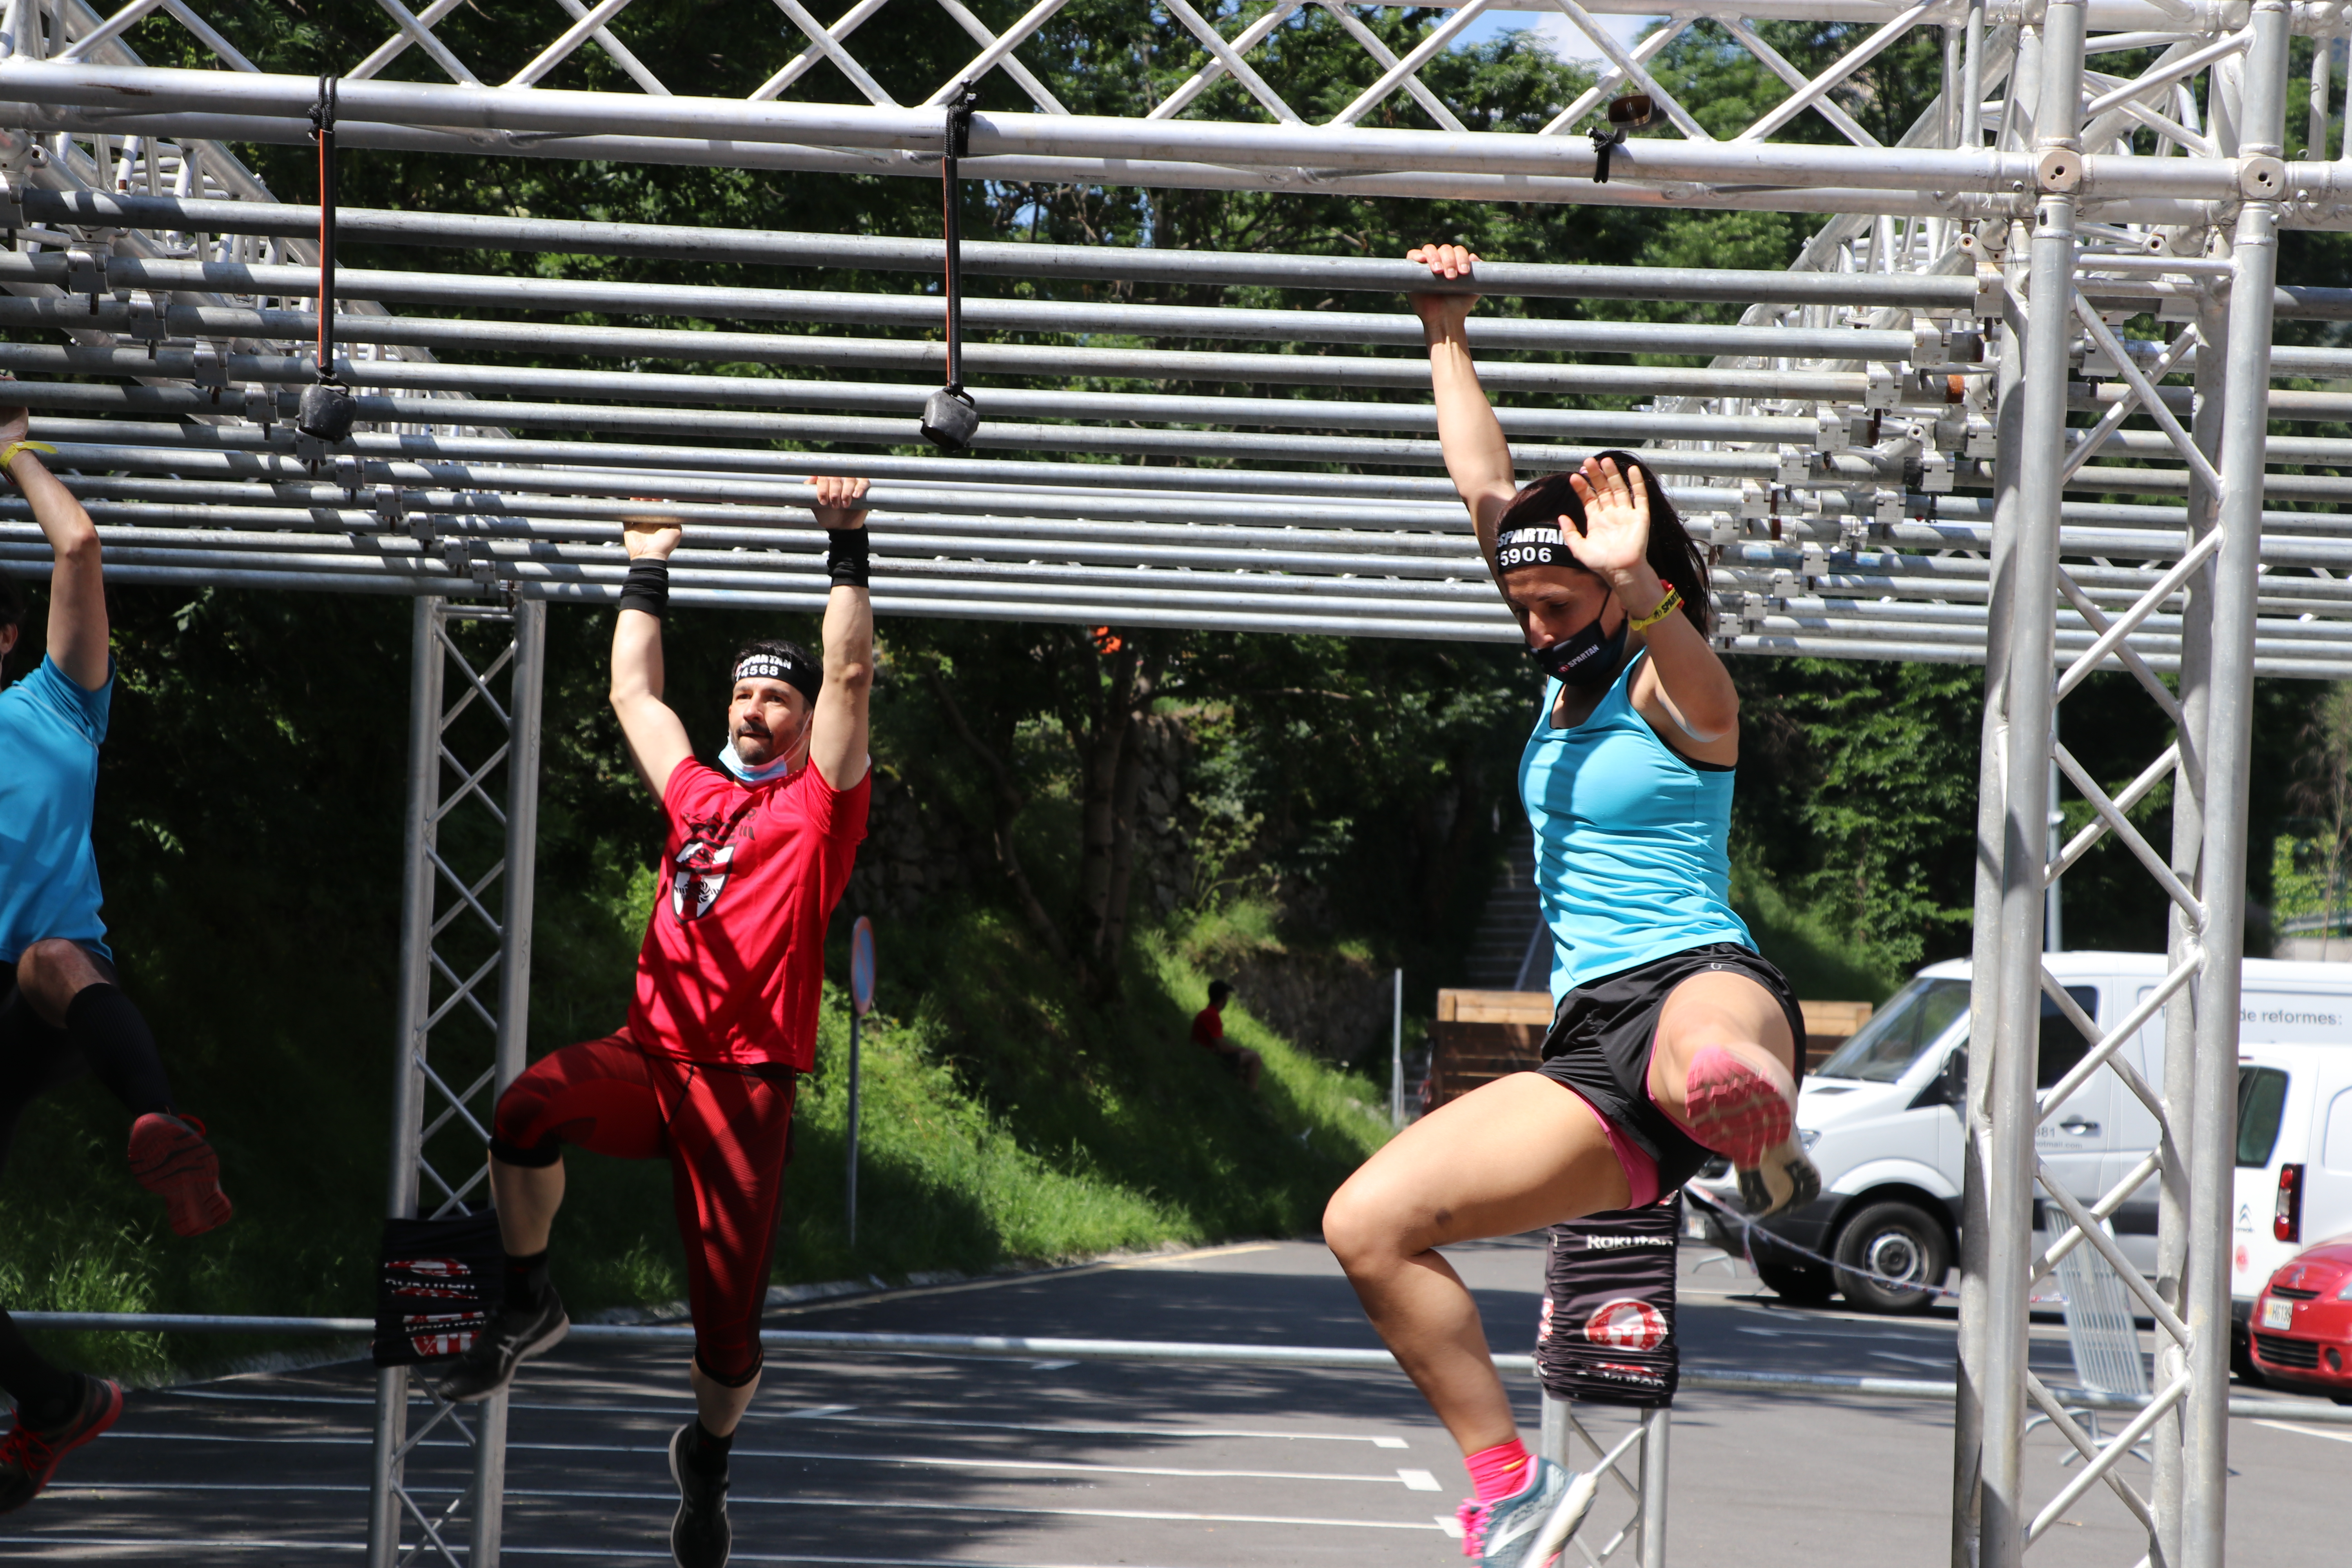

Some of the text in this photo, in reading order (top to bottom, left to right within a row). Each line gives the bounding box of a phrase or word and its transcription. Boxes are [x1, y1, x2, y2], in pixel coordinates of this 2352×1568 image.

[741, 654, 791, 670] SPARTAN
[1568, 644, 1599, 667] SPARTAN
[2240, 1008, 2342, 1025] de reformes:
[2272, 1303, 2292, 1323] H6139
